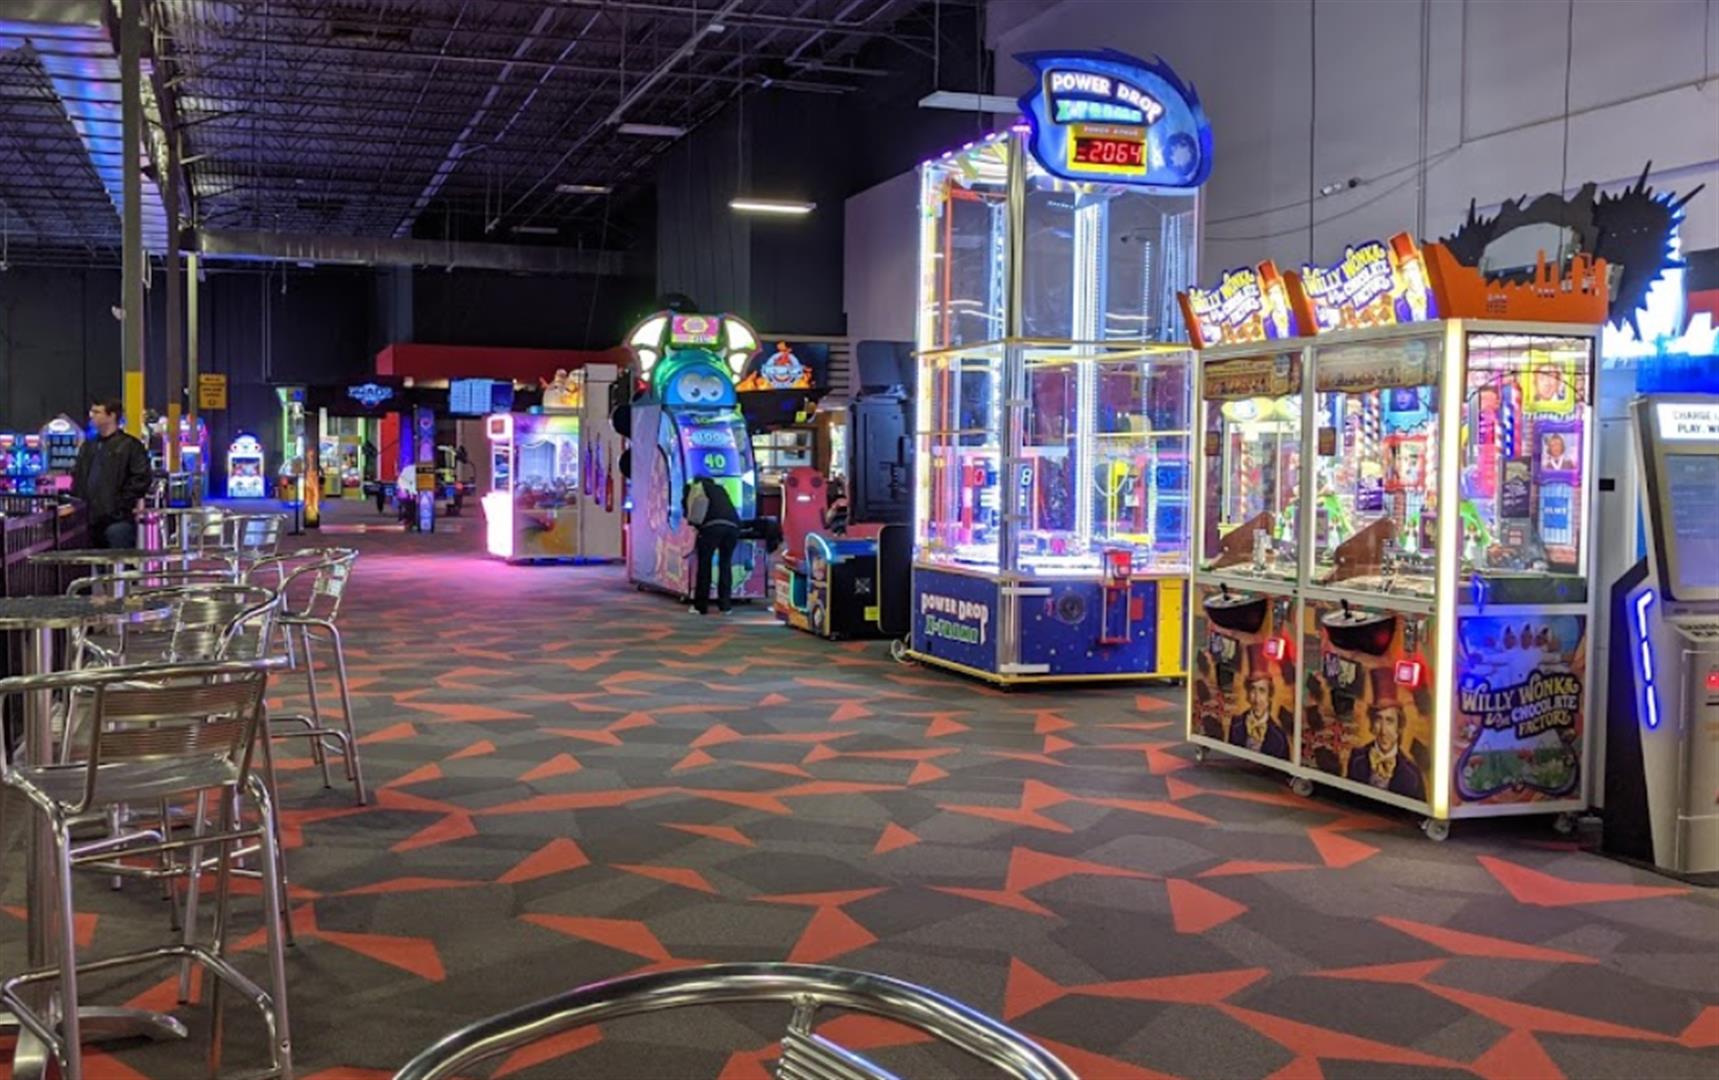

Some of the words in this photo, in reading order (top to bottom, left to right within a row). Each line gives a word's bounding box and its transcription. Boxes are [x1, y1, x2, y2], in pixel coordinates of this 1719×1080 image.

[1052, 71, 1112, 96] POWER
[1116, 82, 1163, 124] DROP
[1088, 141, 1142, 164] 2064
[704, 453, 726, 469] 40
[921, 593, 958, 615] POWER
[958, 600, 988, 645] DROP
[1461, 677, 1515, 712] WILLY
[1518, 674, 1579, 702] WONKA
[1511, 694, 1578, 722] CHOCOLATE
[1518, 711, 1572, 737] FACTORY
